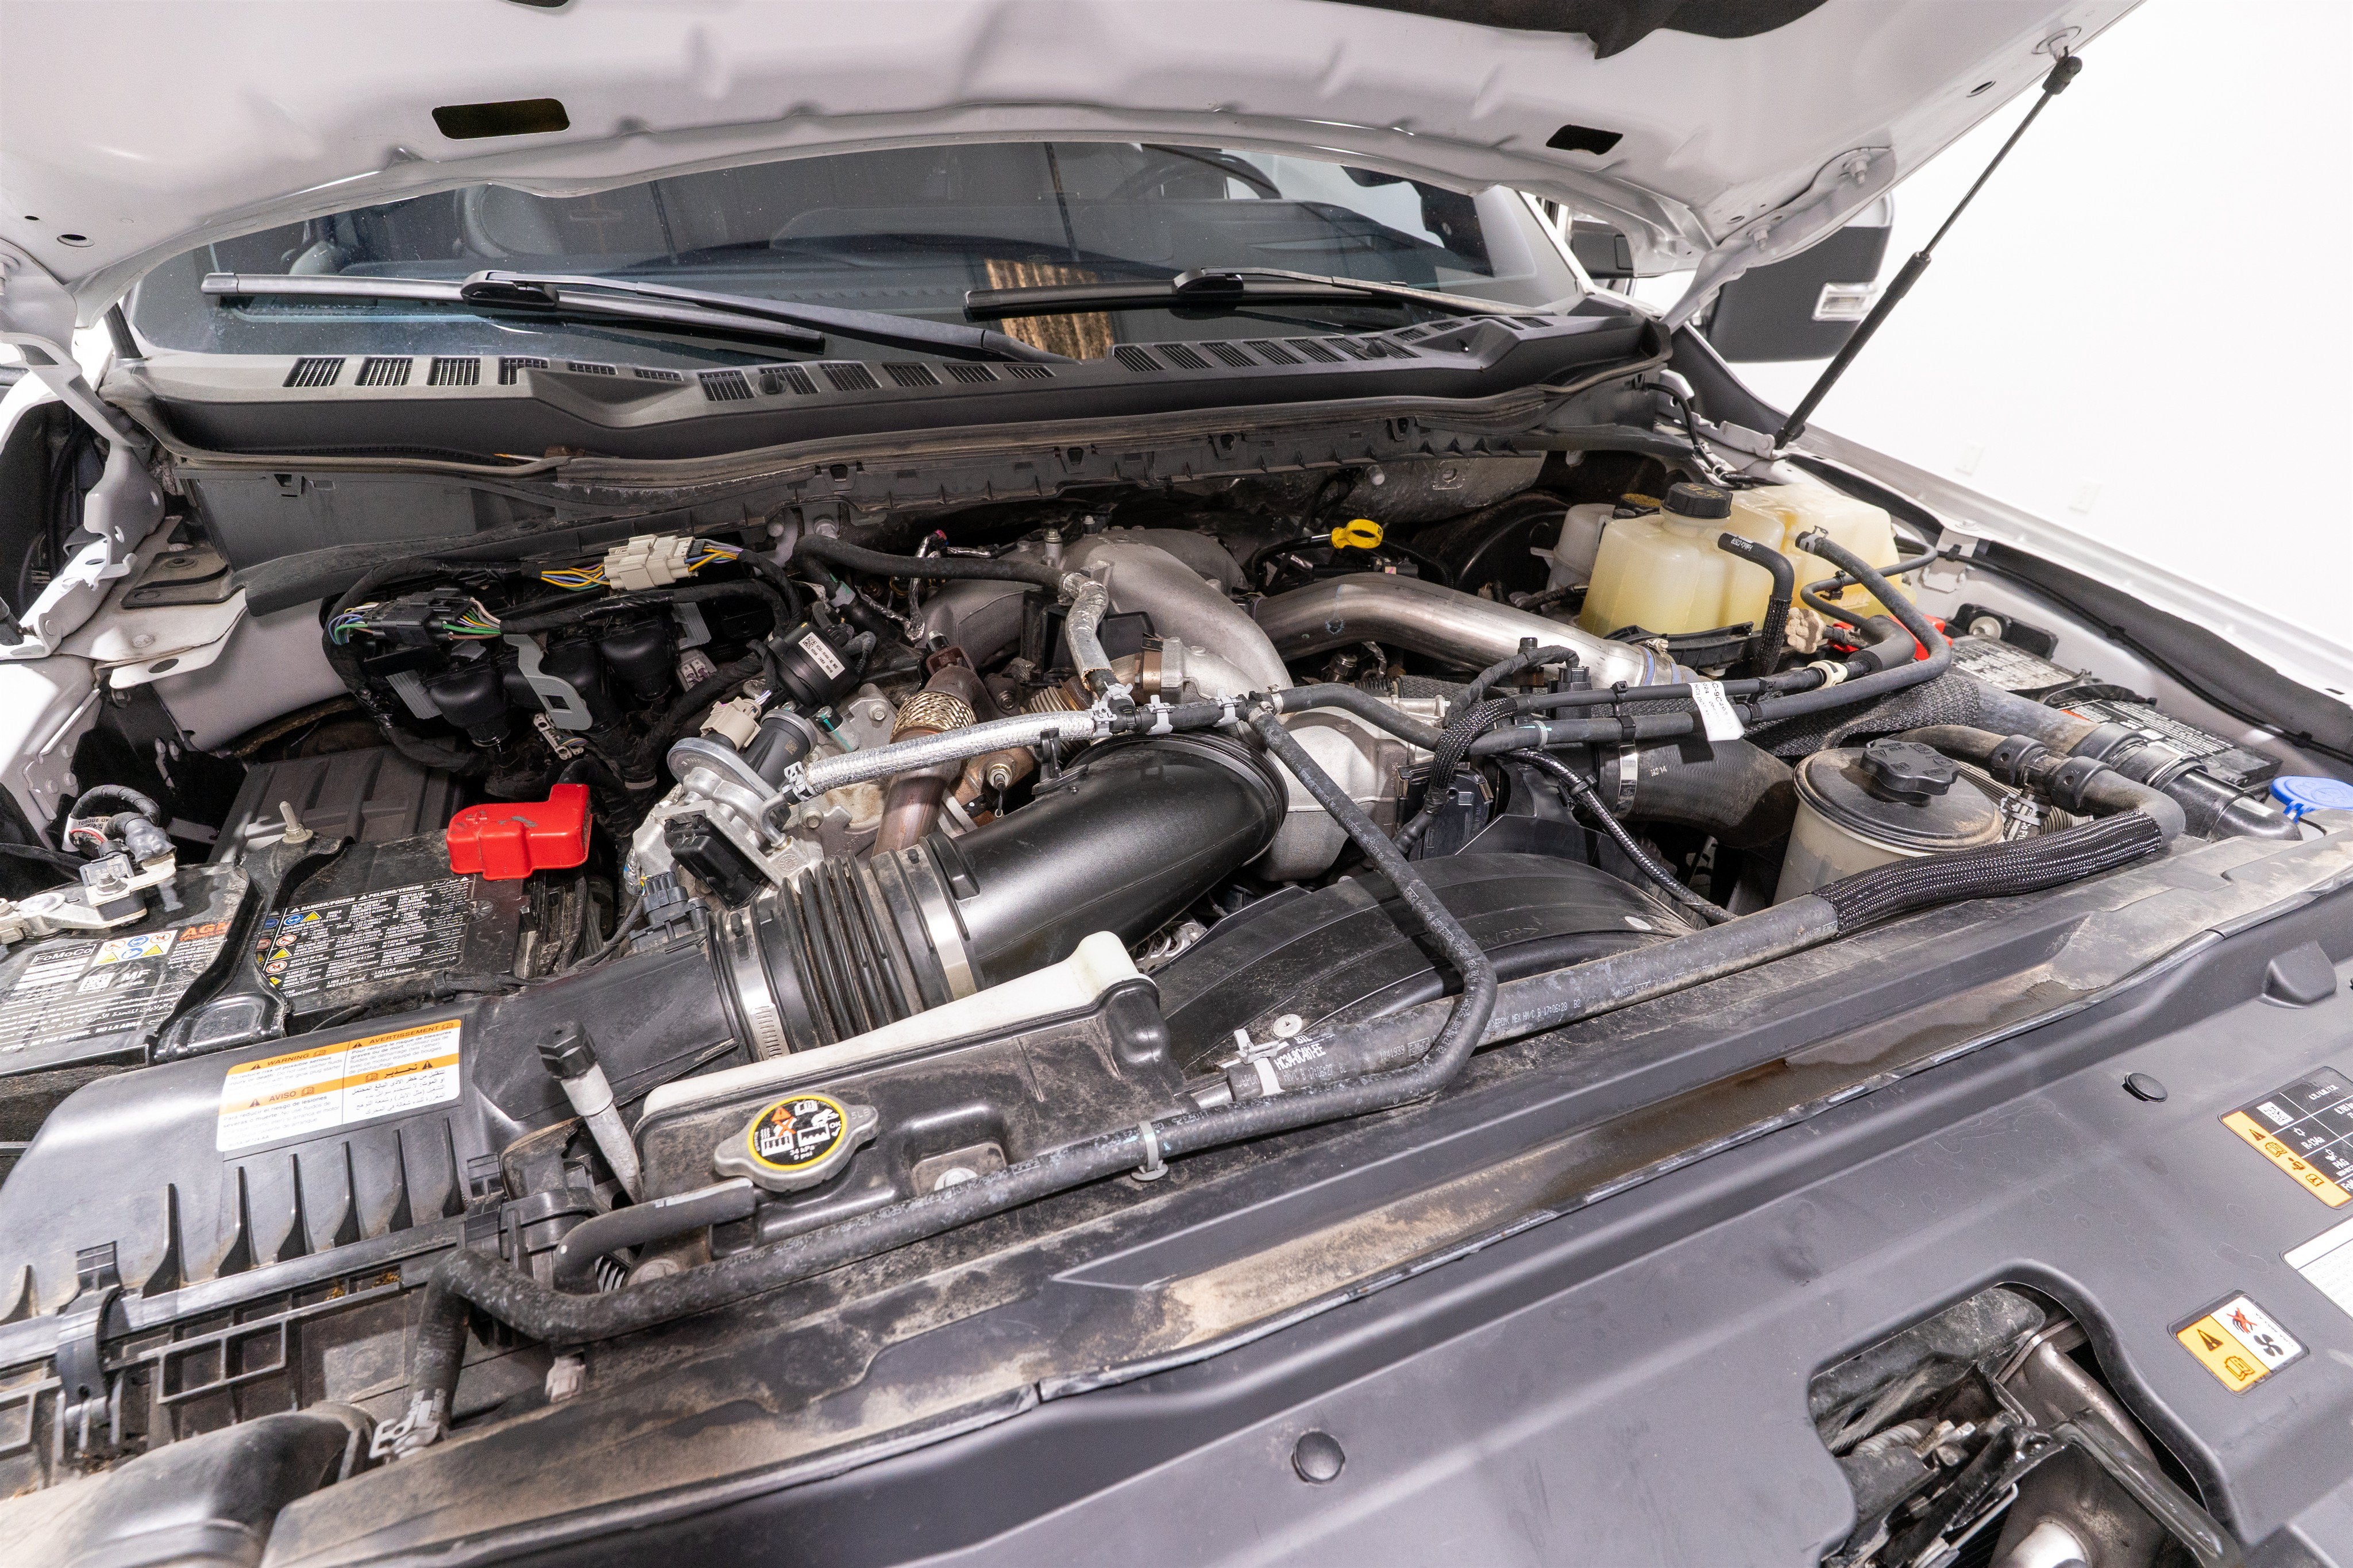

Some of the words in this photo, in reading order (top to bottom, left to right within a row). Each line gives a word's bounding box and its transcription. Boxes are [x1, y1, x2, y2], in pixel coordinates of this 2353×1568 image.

[78, 818, 99, 826] TORQUE
[368, 884, 424, 898] PELIGRO/VENENO
[300, 897, 356, 911] DANGER/POISON
[282, 922, 306, 930] EXPLOSIVE
[35, 948, 92, 963] FoMoCo
[121, 969, 151, 982] MF
[373, 966, 417, 979] INSTRUCCIONES.
[325, 976, 367, 988] INSTRUCTIONS.
[367, 1043, 388, 1051] réduire
[424, 1030, 452, 1039] blessures
[369, 1025, 439, 1044] AVERTISSEMENT
[267, 1053, 309, 1066] WARNING
[372, 1056, 391, 1064] moteur
[421, 1046, 442, 1054] bougies
[377, 1048, 407, 1058] démarrage
[282, 1060, 308, 1069] possible
[310, 1056, 331, 1064] serious
[269, 1090, 296, 1102] AVISO
[271, 1103, 290, 1111] riesgo
[301, 1095, 327, 1104] lesiones
[829, 1121, 842, 1129] OK
[800, 1144, 816, 1154] kPa
[800, 1150, 813, 1160] psi
